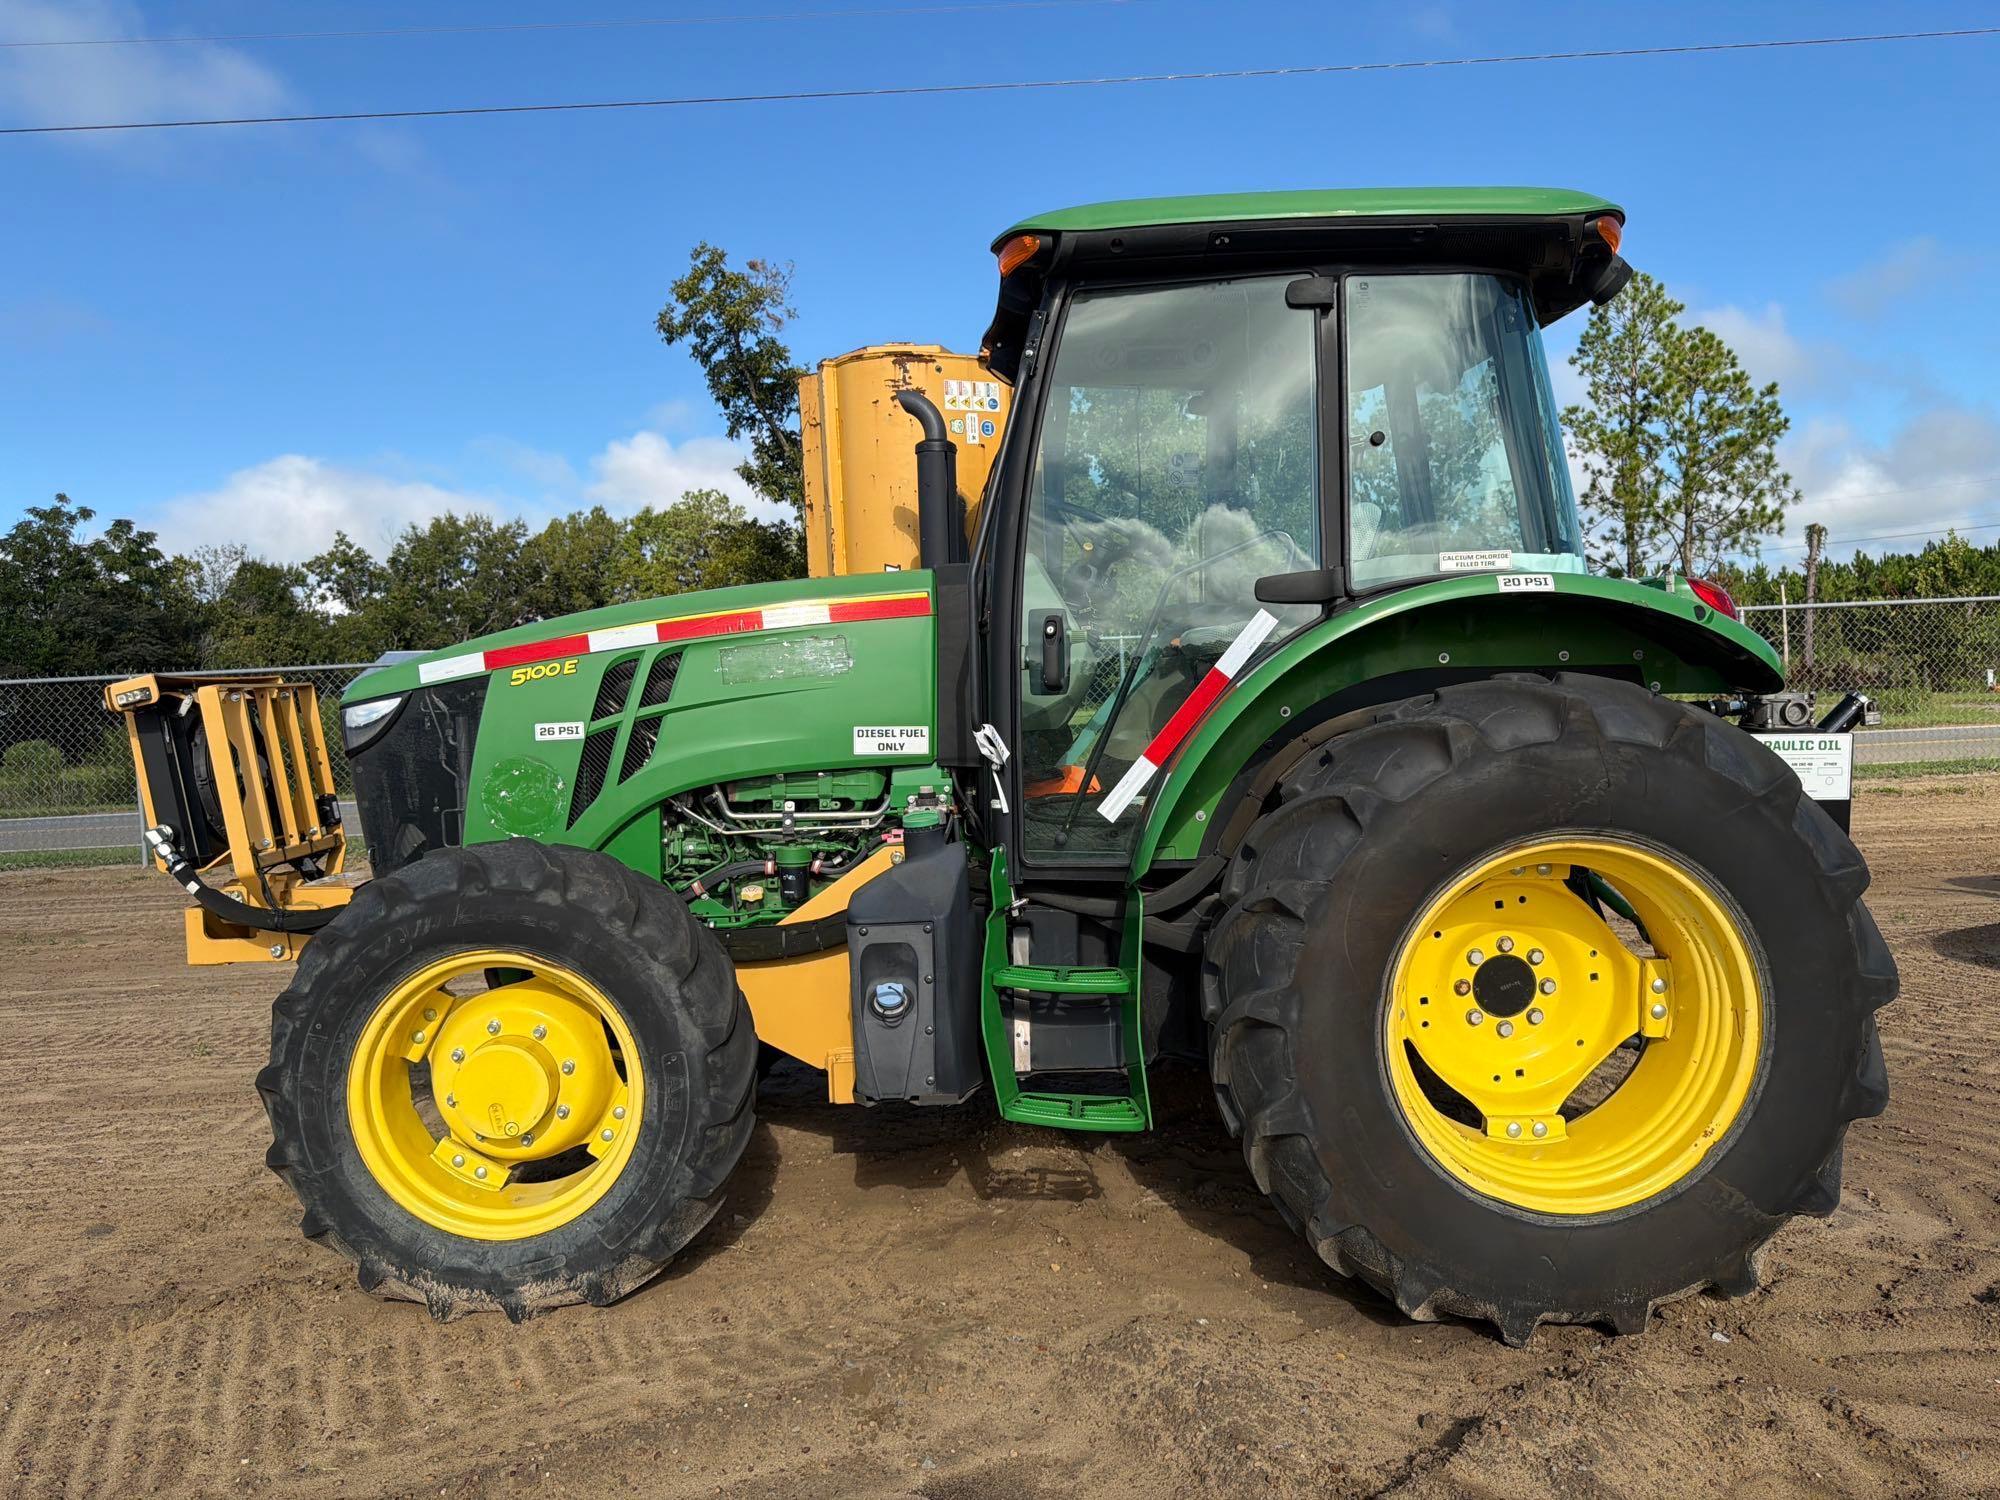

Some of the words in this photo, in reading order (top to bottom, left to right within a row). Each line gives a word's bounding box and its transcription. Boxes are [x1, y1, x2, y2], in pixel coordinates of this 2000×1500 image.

[1503, 577, 1521, 587] 20
[1525, 577, 1549, 586] PSI
[510, 662, 561, 686] 5100
[539, 726, 555, 736] 26
[558, 725, 580, 735] PSI
[857, 729, 897, 738] DIESEL
[899, 728, 926, 738] FUEL
[877, 742, 905, 751] ONLY
[1818, 740, 1842, 751] OIL
